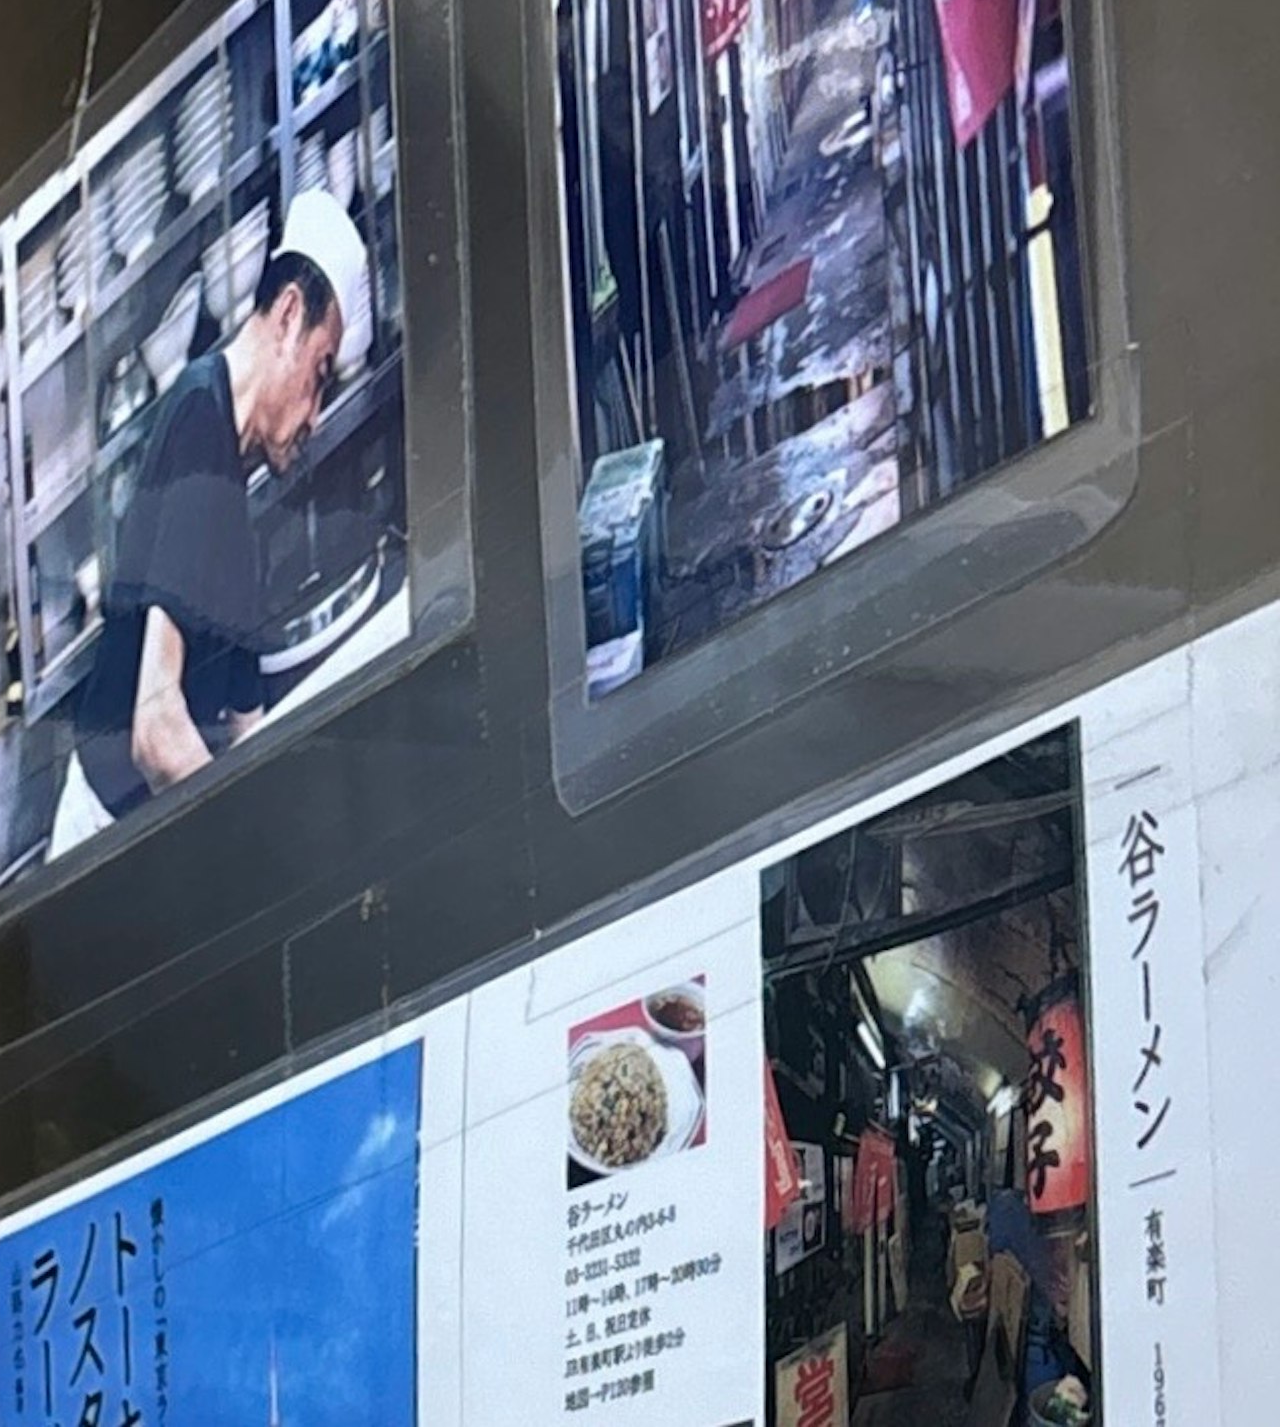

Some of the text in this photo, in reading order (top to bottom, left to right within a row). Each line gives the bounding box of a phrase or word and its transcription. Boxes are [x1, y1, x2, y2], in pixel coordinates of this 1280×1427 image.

[1118, 810, 1172, 1149] 谷ラーメン
[567, 1191, 628, 1228] 谷ラーメン
[1144, 1209, 1167, 1427] 有楽町 196
